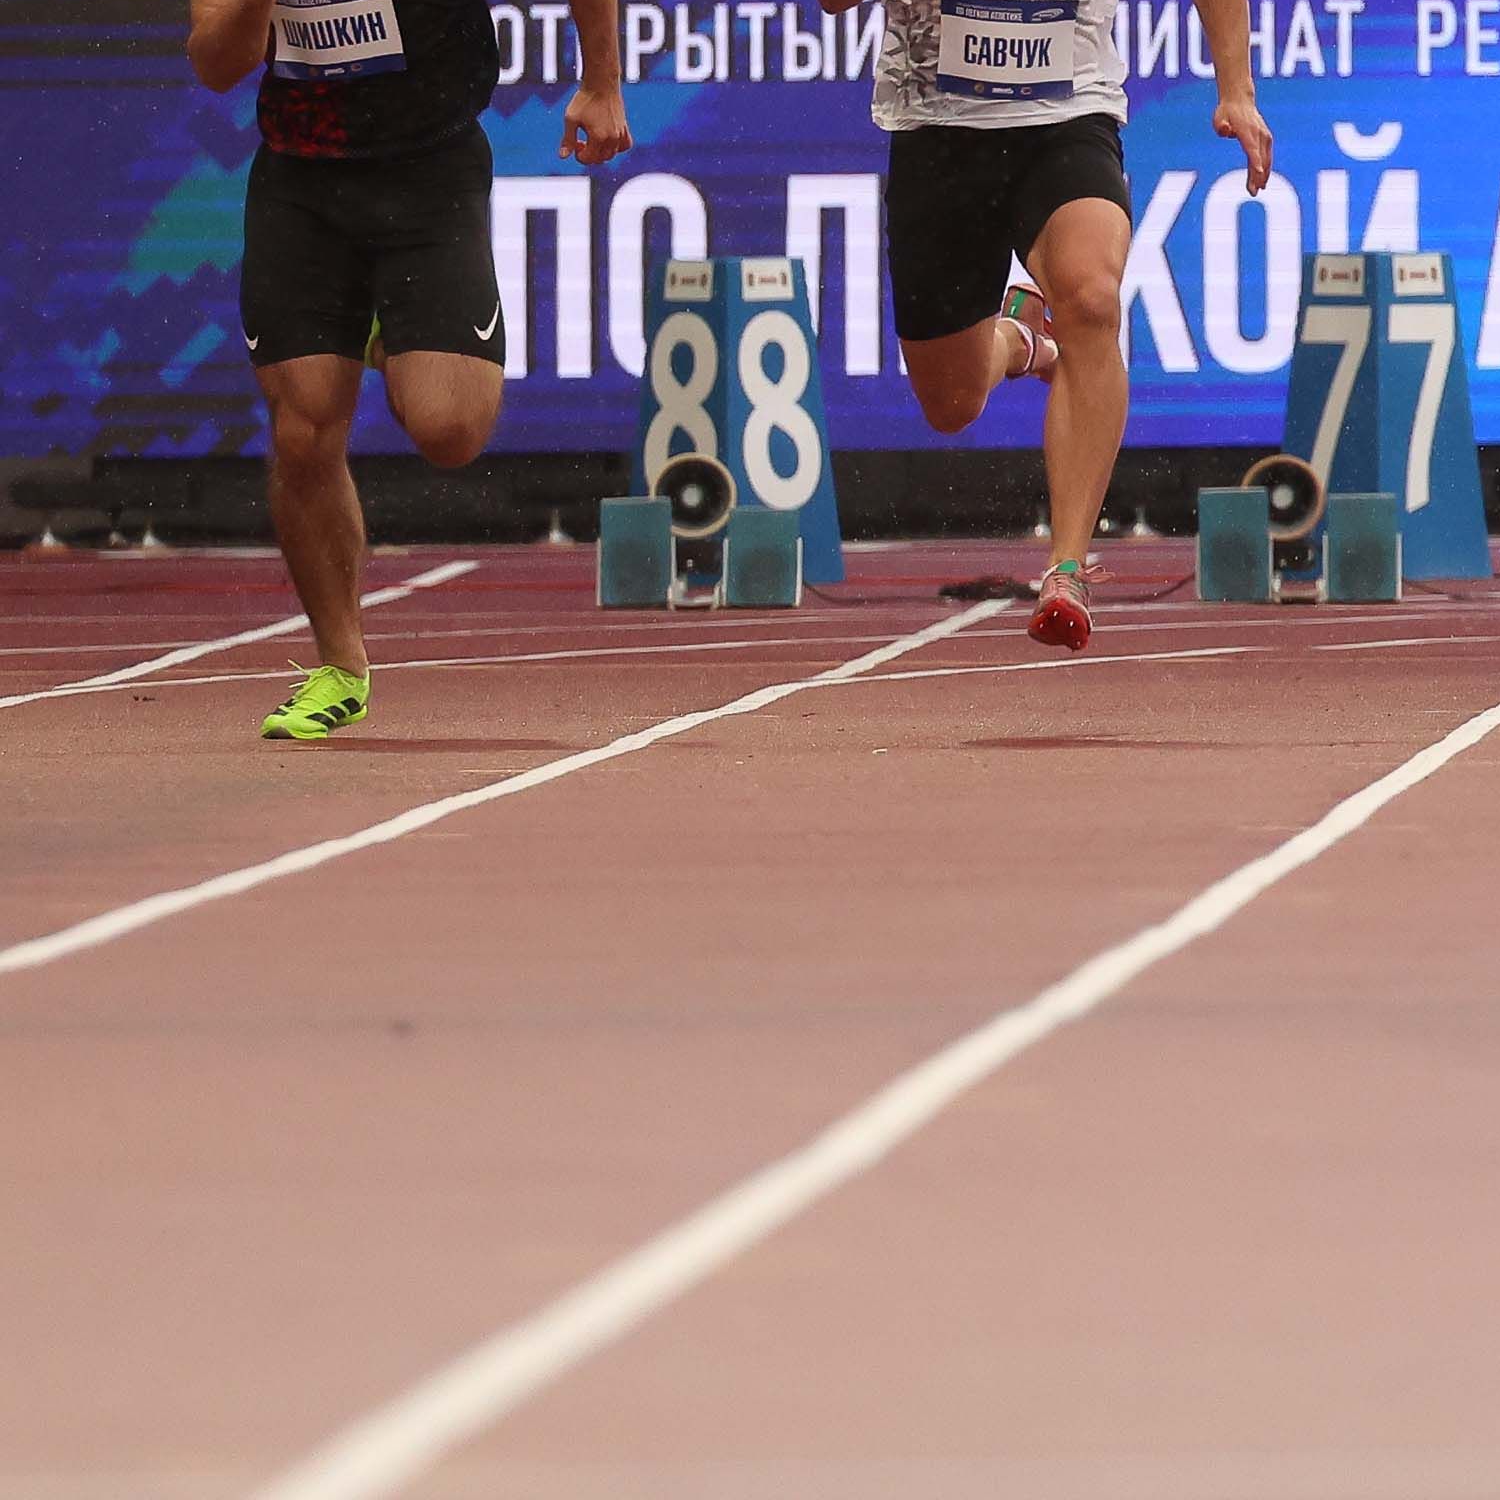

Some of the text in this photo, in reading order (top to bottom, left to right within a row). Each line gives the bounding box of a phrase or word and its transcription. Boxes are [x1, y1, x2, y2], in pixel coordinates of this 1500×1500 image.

[281, 11, 387, 50] ШИШКИН
[964, 34, 1052, 68] САВЧУК
[738, 309, 823, 512] 8
[1387, 303, 1456, 514] 7
